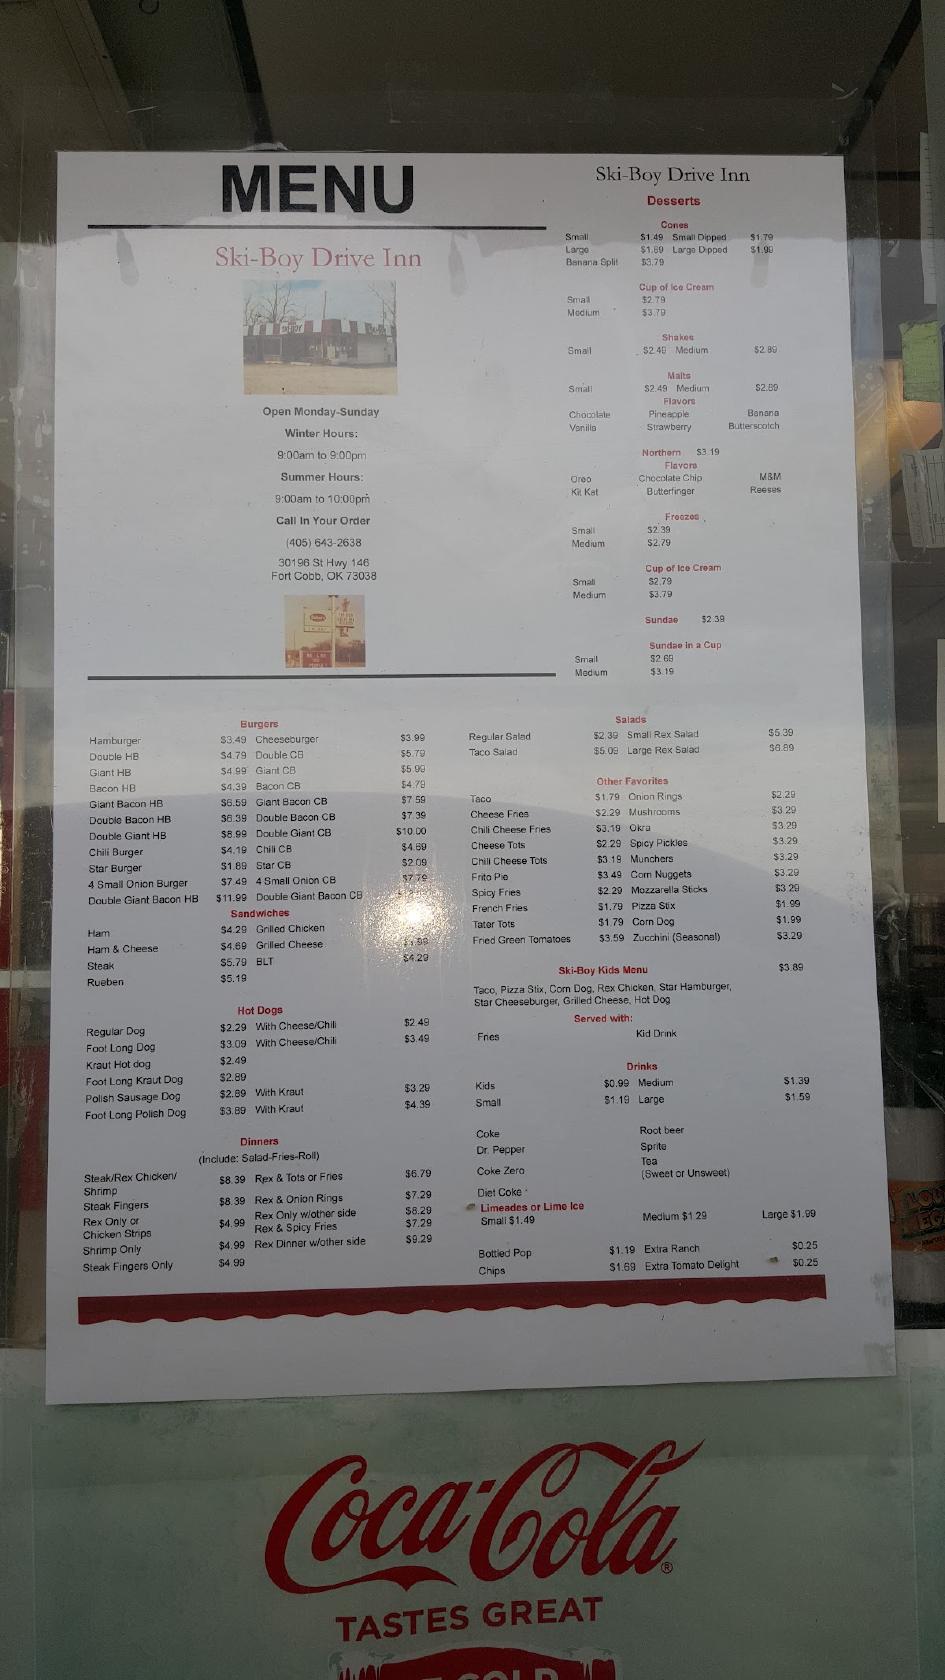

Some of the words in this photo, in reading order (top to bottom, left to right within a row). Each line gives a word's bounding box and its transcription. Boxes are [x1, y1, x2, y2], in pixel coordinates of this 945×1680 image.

[595, 165, 662, 188] Ski-Boy
[667, 166, 715, 183] Drive
[719, 167, 751, 183] Inn
[221, 164, 414, 214] MENU
[647, 195, 702, 207] Desserts
[660, 219, 689, 230] Cones
[564, 232, 589, 242] Small
[639, 232, 664, 243] $1.49
[671, 233, 696, 243] Small
[697, 232, 727, 244] Dipped
[749, 233, 775, 243] $1.79
[215, 245, 305, 272] Ski-Boy
[311, 247, 376, 268] Drive
[381, 247, 423, 268] Inn
[262, 405, 292, 419] Open
[293, 406, 380, 419] Monday-Sunday
[284, 427, 321, 439] Winter
[322, 427, 359, 439] Hours:
[277, 449, 315, 461] 9:00am
[317, 450, 328, 461] to
[329, 449, 367, 463] 9:00pm
[641, 448, 682, 457] Northern
[695, 447, 721, 457] $3.19
[280, 471, 326, 482] Summer
[327, 471, 364, 483] Hours:
[759, 471, 782, 481] M&M
[646, 486, 696, 497] Butterfinger
[274, 493, 313, 505] 9:00am
[314, 495, 326, 504] to
[327, 493, 371, 507] 10:00pm
[275, 515, 297, 526] Call
[299, 515, 311, 526] In
[312, 515, 338, 526] Your
[339, 515, 371, 526] Order
[285, 537, 313, 550] (405)
[313, 536, 363, 549] 643-2638
[277, 557, 311, 568] 30196
[312, 557, 325, 568] St
[326, 557, 348, 571] Hwy
[351, 557, 370, 568] 146
[645, 564, 664, 575] Cup
[665, 564, 676, 573] of
[677, 563, 692, 573] Ice
[691, 563, 722, 573] Cream
[271, 571, 292, 582] Fort
[293, 571, 324, 582] Cobb,
[326, 571, 345, 582] OK
[345, 570, 378, 582] 73038
[572, 591, 607, 600] Medium
[648, 589, 673, 599] $3.79
[644, 615, 679, 625] Sundae
[701, 614, 726, 624] $2.39
[648, 641, 684, 651] Sundae
[684, 641, 694, 650] in
[703, 639, 722, 652] Cup
[240, 719, 280, 730] Burgers
[615, 715, 648, 725] Salads
[595, 776, 624, 787] Other
[623, 775, 670, 786] Favorites
[471, 841, 506, 851] Cheese
[506, 840, 526, 850] Tots
[595, 839, 622, 849] $2.29
[88, 847, 110, 857] Chili
[112, 847, 144, 860] Burger
[220, 845, 248, 856] $4.19
[88, 864, 110, 874] Star
[110, 863, 143, 875] Burger
[87, 880, 95, 890] 4
[96, 879, 124, 890] Small
[125, 879, 155, 889] Onion
[155, 879, 189, 890] Burger
[220, 877, 248, 887] $7.49
[471, 903, 504, 913] French
[505, 903, 529, 913] Fries
[597, 901, 624, 912] $1.79
[631, 901, 657, 912] Pizza
[658, 901, 676, 911] Stix
[775, 899, 801, 909] $1.99
[230, 908, 291, 919] Sandwiches
[631, 917, 655, 927] Corn
[656, 916, 675, 928] Dog
[775, 915, 802, 925] $1.99
[87, 929, 112, 938] Ham
[255, 924, 286, 934] Grilled
[287, 923, 326, 934] Chicken
[632, 932, 670, 943] Zucchini
[671, 931, 721, 944] (Seasonal)
[87, 945, 111, 955] Ham
[112, 944, 120, 955] &
[121, 944, 159, 954] Cheese
[255, 940, 286, 950] Grilled
[287, 939, 324, 950] Cheese
[87, 961, 115, 972] Steak
[255, 956, 274, 967] BLT
[558, 965, 596, 977] Ski-Boy
[597, 965, 621, 975] Kids
[622, 965, 649, 975] Menu
[87, 977, 125, 988] Rueben
[219, 973, 248, 984] $5.19
[237, 1005, 255, 1016] Hot
[257, 1005, 284, 1017] Dogs
[573, 1013, 608, 1024] Served
[609, 1013, 633, 1023] with:
[86, 1027, 125, 1039] Regular
[125, 1026, 146, 1038] Dog
[219, 1022, 248, 1034] $2.29
[635, 1028, 652, 1039] Kid
[653, 1028, 678, 1039] Drink
[255, 1038, 278, 1048] With
[278, 1035, 337, 1048] Cheese/Chili
[404, 1033, 431, 1044] $3.49
[85, 1060, 112, 1071] Kraut
[113, 1059, 132, 1070] Hot
[132, 1059, 152, 1071] dog
[219, 1055, 248, 1067] $2.49
[626, 1061, 659, 1072] Drinks
[475, 1081, 496, 1091] Kids
[603, 1078, 631, 1089] $0.99
[474, 1129, 501, 1140] Coke
[639, 1125, 662, 1136] Root
[663, 1125, 685, 1135] beer
[239, 1136, 280, 1147] Dinners
[476, 1145, 489, 1156] Dr.
[492, 1145, 526, 1157] Pepper
[198, 1153, 240, 1167] (Include:
[241, 1151, 320, 1164] Salad-Fries-Roll)
[476, 1165, 502, 1177] Coke
[503, 1165, 526, 1176] Zero
[641, 1169, 674, 1181] (Sweet
[675, 1169, 686, 1179] or
[687, 1167, 731, 1179] Unsweet)
[254, 1195, 275, 1205] Rex
[275, 1195, 284, 1205] &
[285, 1194, 315, 1205] Onion
[315, 1192, 344, 1206] Rings
[404, 1189, 433, 1201] $7.29
[480, 1202, 529, 1213] Limeades
[529, 1203, 542, 1213] or
[543, 1202, 568, 1212] Lime
[569, 1201, 585, 1211] Ice
[82, 1245, 118, 1257] Shrimp
[119, 1244, 143, 1257] Only
[218, 1239, 246, 1252] $4.99
[643, 1244, 669, 1255] Extra
[670, 1243, 701, 1254] Ranch
[791, 1240, 819, 1252] $0.25
[263, 1437, 707, 1595] Coca-Cola
[334, 1604, 470, 1643] TASTES
[481, 1595, 605, 1629] GREAT
